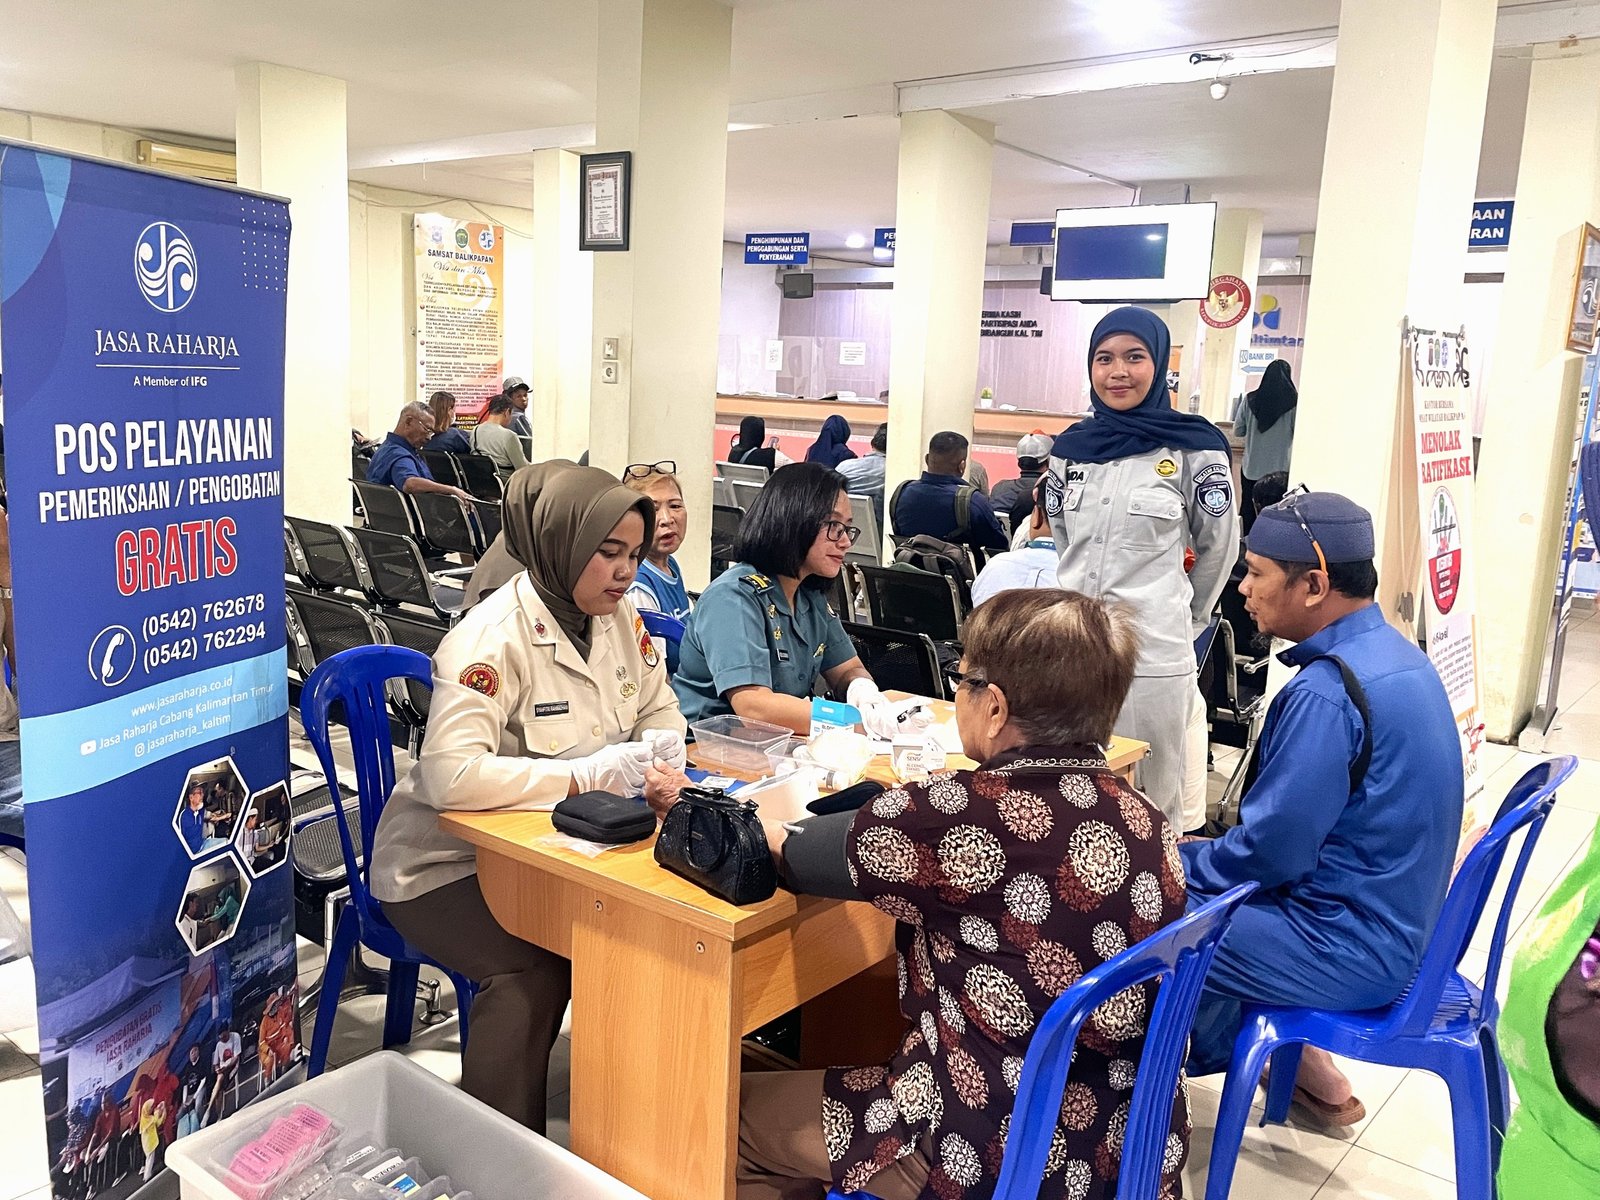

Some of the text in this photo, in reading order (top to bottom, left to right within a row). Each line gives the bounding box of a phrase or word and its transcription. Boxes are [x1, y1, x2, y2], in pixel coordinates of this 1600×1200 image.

[793, 236, 805, 244] DAN
[1470, 227, 1504, 239] RAN
[427, 249, 494, 263] SAMSAT BALIKPAPAN
[95, 329, 240, 360] JASA RAHARJA
[133, 376, 208, 388] A Member of IFG
[54, 417, 273, 475] POS PELAYANAN
[1421, 430, 1461, 454] MENOLAK
[39, 470, 281, 523] PEMERIKSAAN / PENGOBATAN
[115, 516, 239, 596] GRATIS
[142, 593, 265, 643] (0542) 762678
[143, 621, 266, 674] (0542) 762294
[98, 682, 274, 751] Jasa Raharja Cabang Kalimantan Timur
[131, 675, 233, 718] www.jasaraharja.co.id
[147, 714, 231, 753] jasaraharja_kaltim
